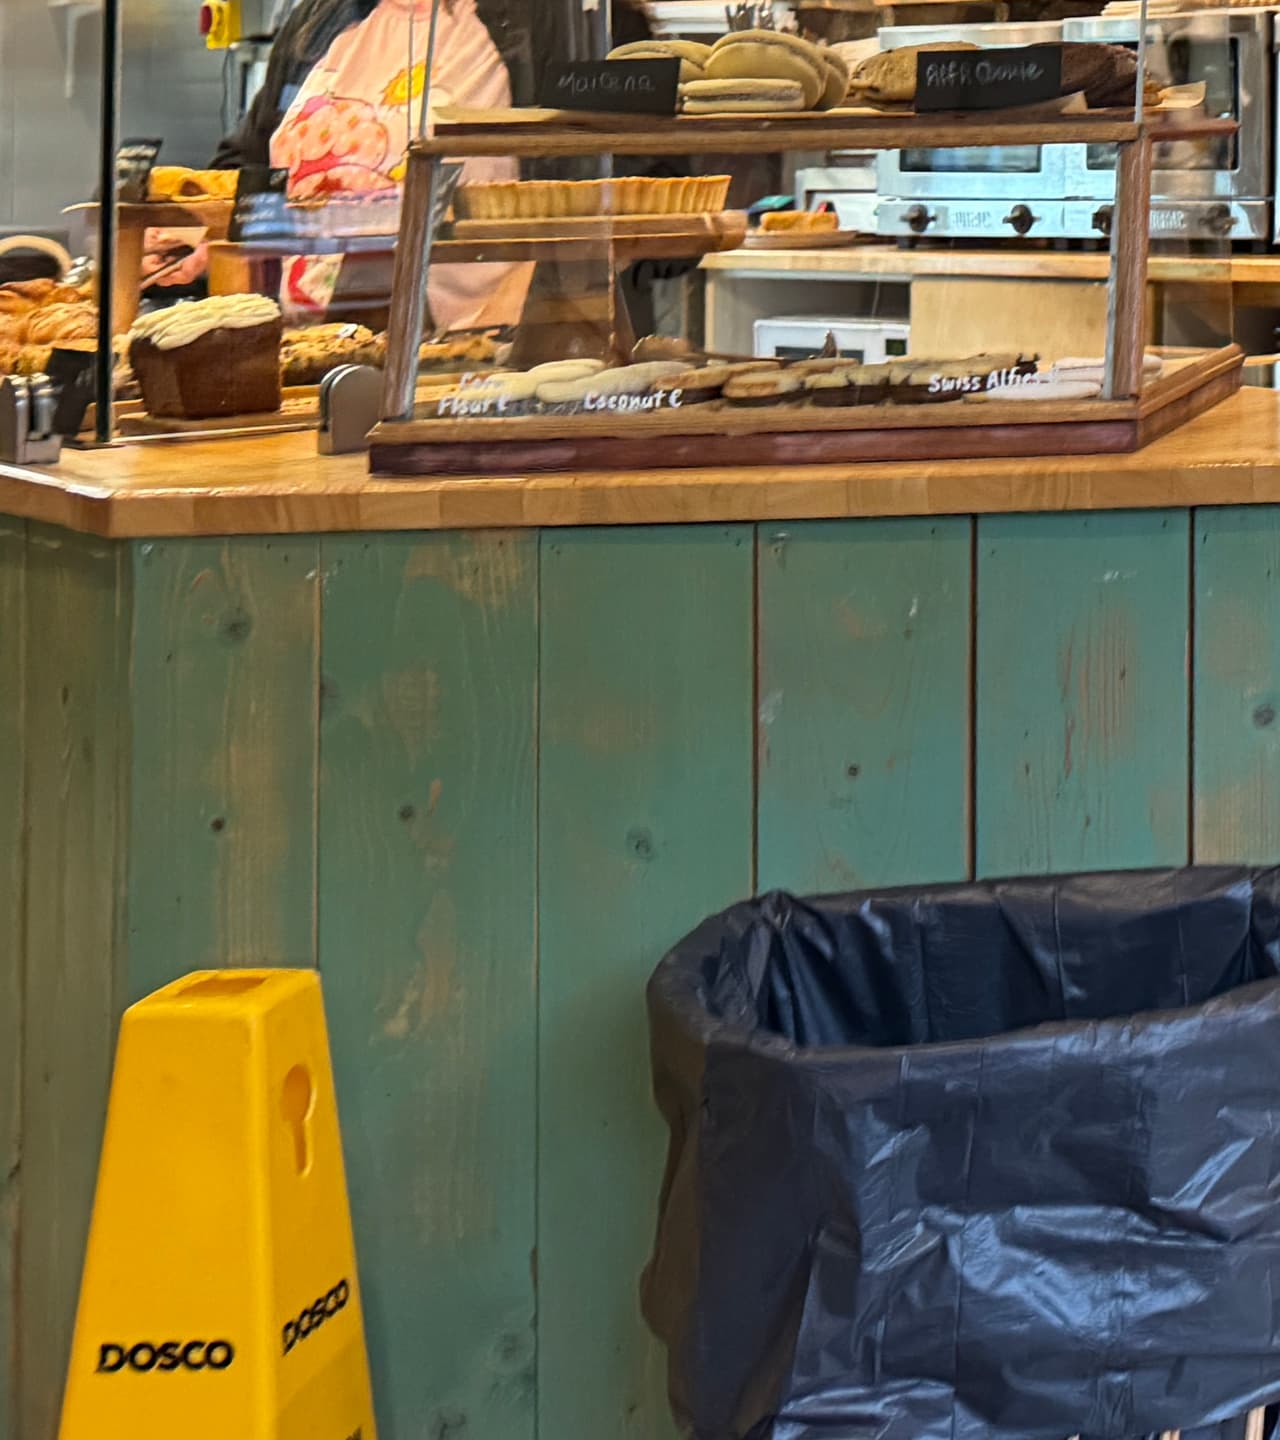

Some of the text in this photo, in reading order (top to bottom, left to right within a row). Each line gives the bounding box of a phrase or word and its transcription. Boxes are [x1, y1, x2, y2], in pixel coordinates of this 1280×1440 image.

[927, 371, 982, 394] Swiss
[582, 388, 667, 413] Coconut
[281, 1277, 350, 1358] DOSCO
[95, 1338, 236, 1374] DOSCO
